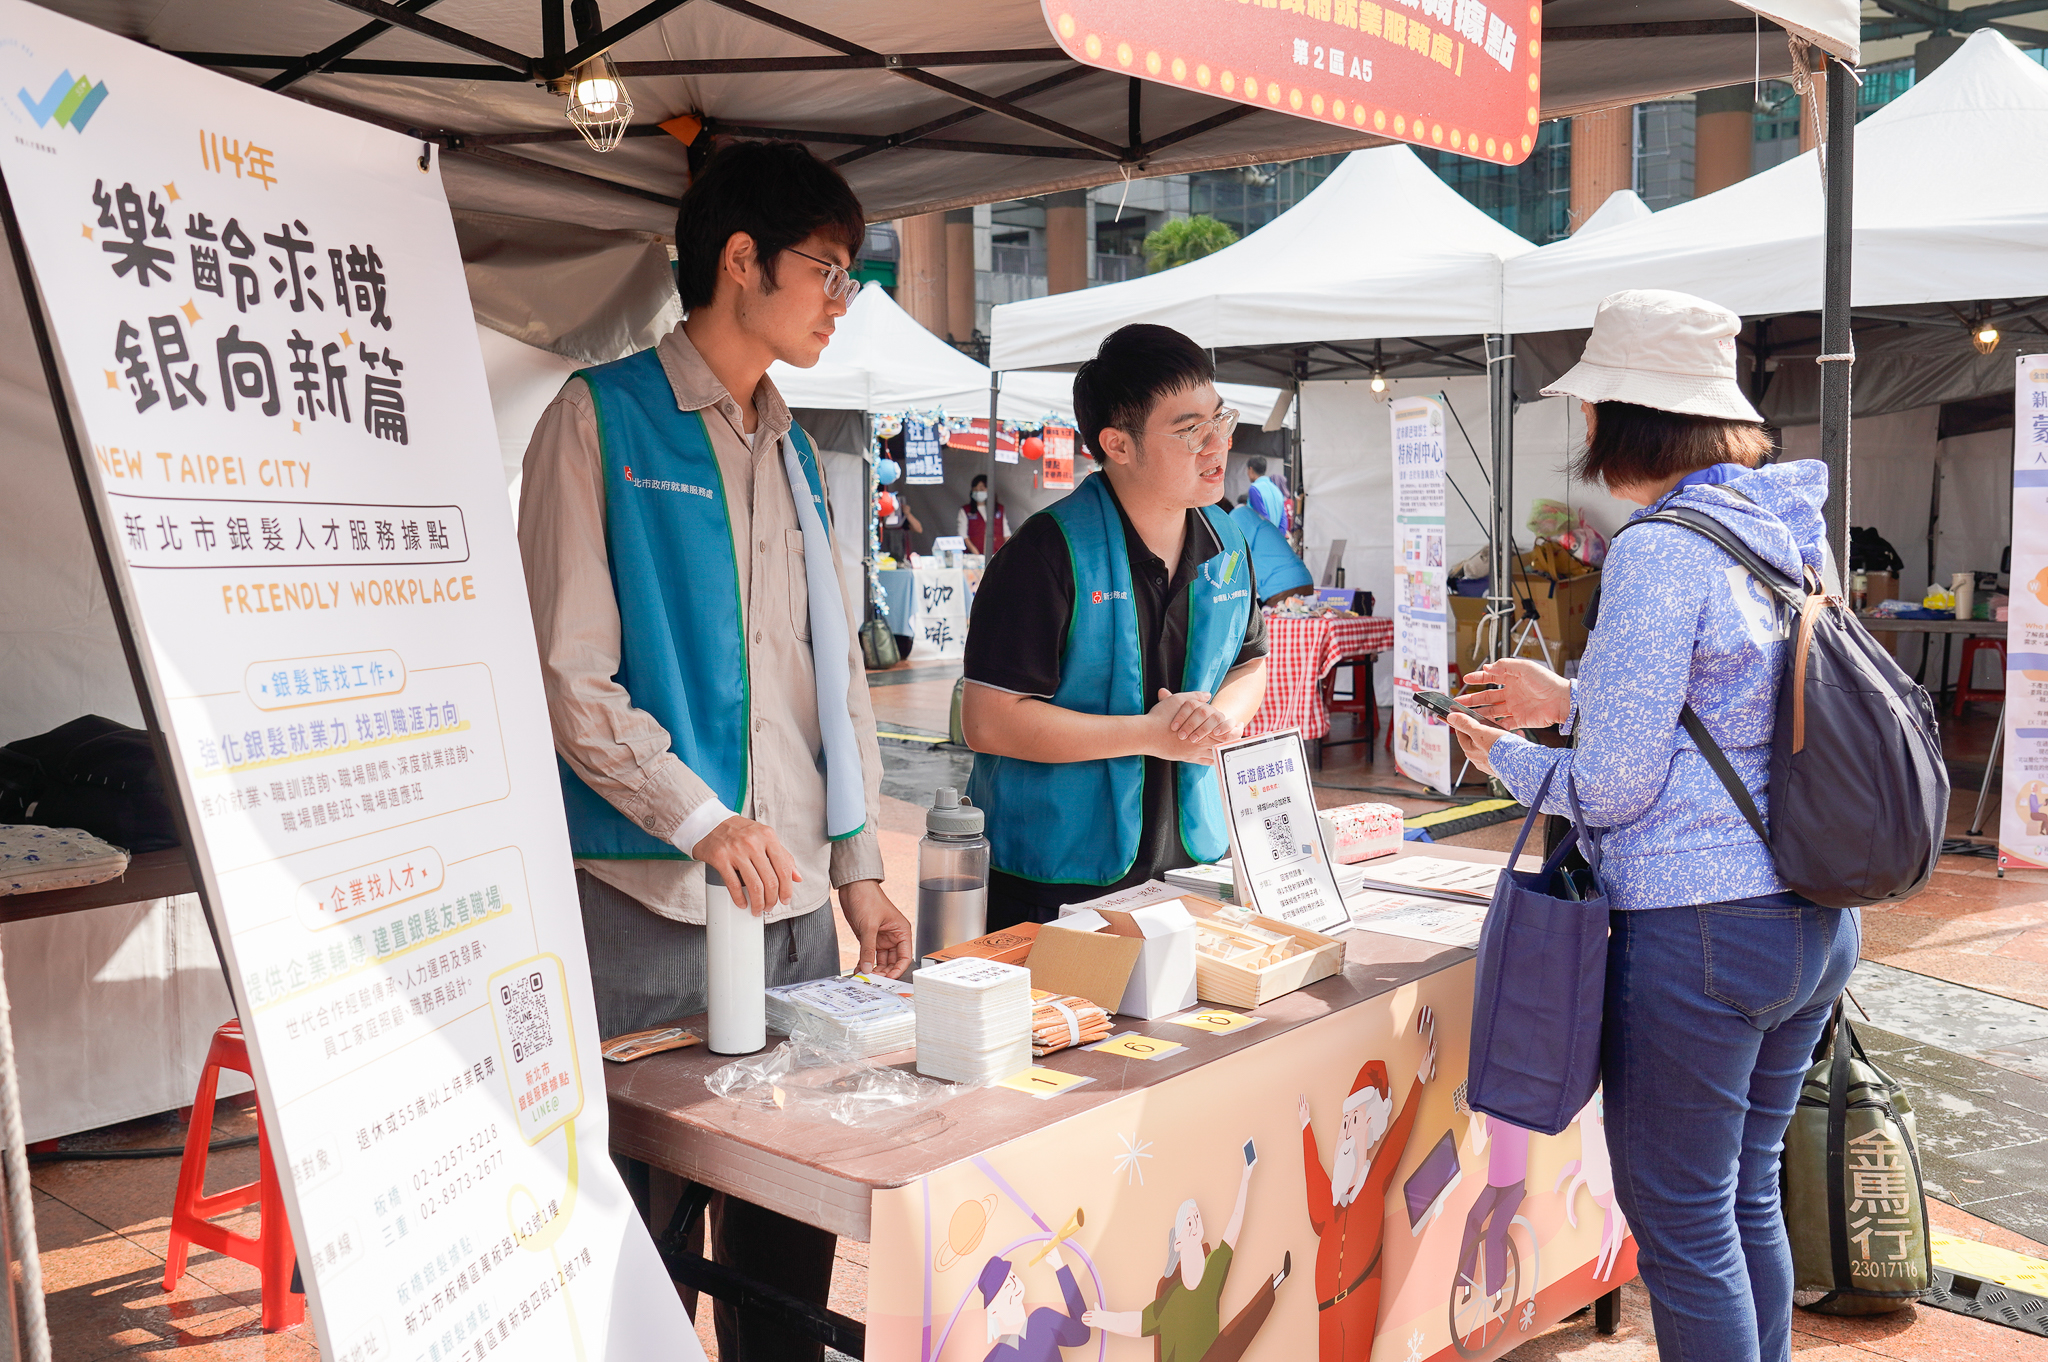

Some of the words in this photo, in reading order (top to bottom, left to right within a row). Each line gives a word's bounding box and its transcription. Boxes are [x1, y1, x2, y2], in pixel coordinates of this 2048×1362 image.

[200, 129, 278, 190] 114年
[92, 179, 392, 332] 樂齡求職
[115, 315, 409, 445] 銀向新篇
[95, 444, 143, 480] NEW
[156, 452, 247, 486] TAIPEI
[258, 459, 311, 488] CITY
[124, 512, 450, 553] 新北市銀髮人才服務據點
[221, 581, 340, 614] FRIENDLY
[350, 575, 476, 607] WORKPLACE
[923, 578, 954, 652] 咖啡
[271, 661, 385, 698] 銀髮族找工作
[198, 716, 349, 769] 強化銀髮就業力
[355, 700, 459, 741] 找到職涯方向
[1236, 758, 1294, 785] 玩遊戲送好禮
[281, 782, 425, 833] 職場體驗班、職場適應班
[330, 862, 416, 914] 企業找人才
[246, 934, 368, 1006] 提供企業輔導
[371, 884, 503, 957] 建置銀髮友善職場
[356, 1055, 496, 1152] 退休或55歲以上待業民眾
[525, 1061, 551, 1086] 新北市
[532, 1096, 560, 1122] LINE@
[373, 1184, 402, 1218] 板橋
[413, 1123, 498, 1191] 02-2257-5218
[381, 1214, 410, 1248] 三重
[420, 1150, 504, 1220] 02-8973-2677
[1848, 1128, 1913, 1261] 金馬行
[396, 1234, 474, 1307] 板橋銀髮據點
[404, 1198, 560, 1336] 新北市板橋區萬板路143號1樓
[1852, 1260, 1918, 1279] 23017116
